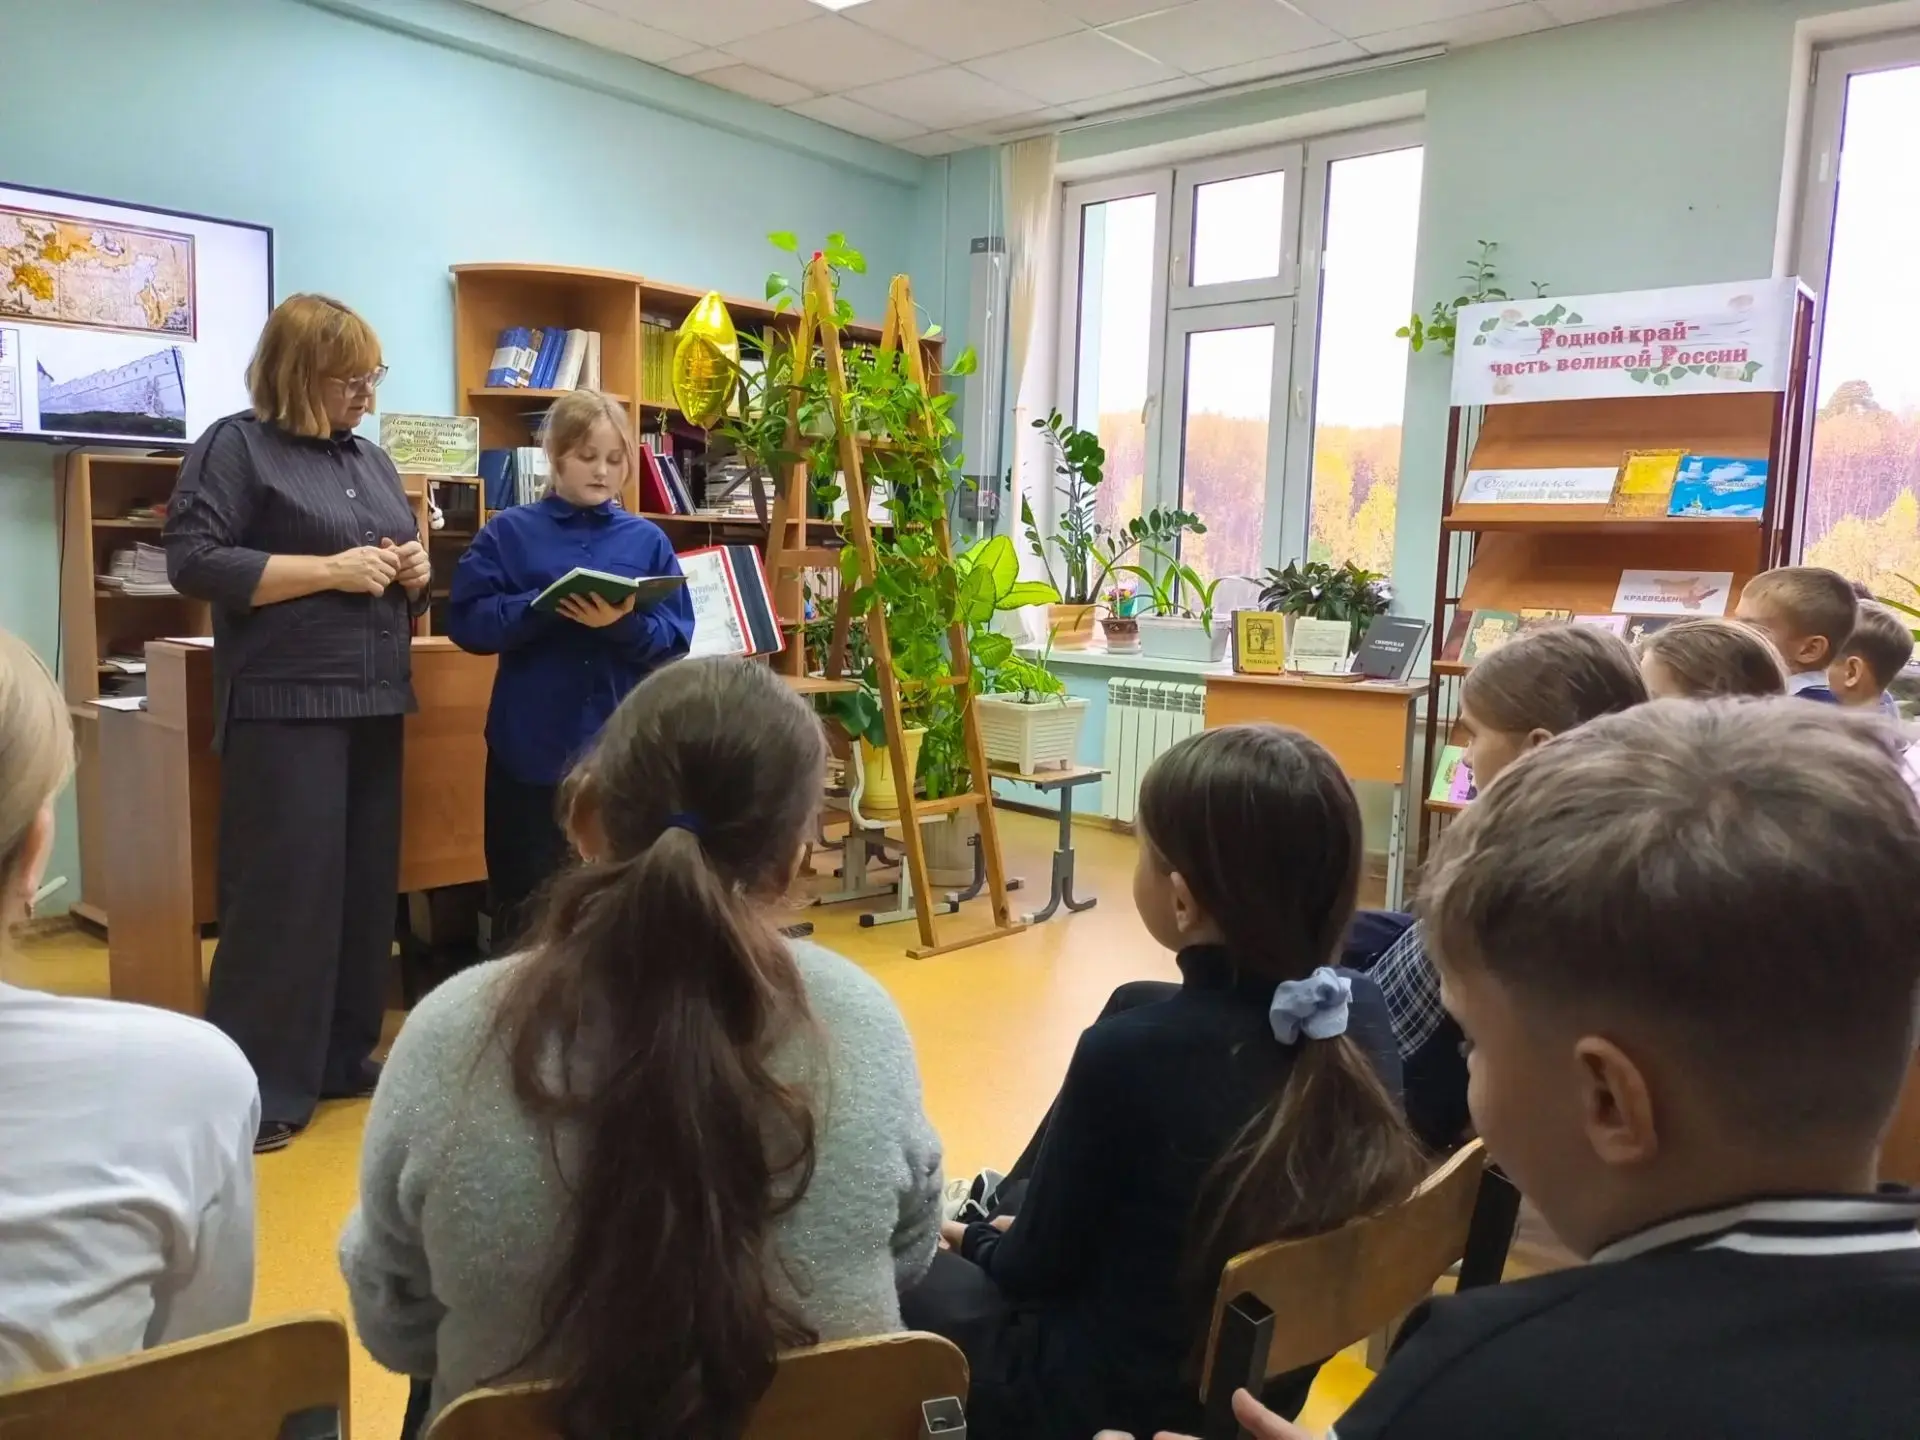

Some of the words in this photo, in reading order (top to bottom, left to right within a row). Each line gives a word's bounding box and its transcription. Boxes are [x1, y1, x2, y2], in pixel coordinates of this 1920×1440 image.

[1537, 325, 1624, 353] Родной
[1489, 358, 1551, 378] часть
[1556, 349, 1652, 372] великой
[1658, 345, 1749, 371] России
